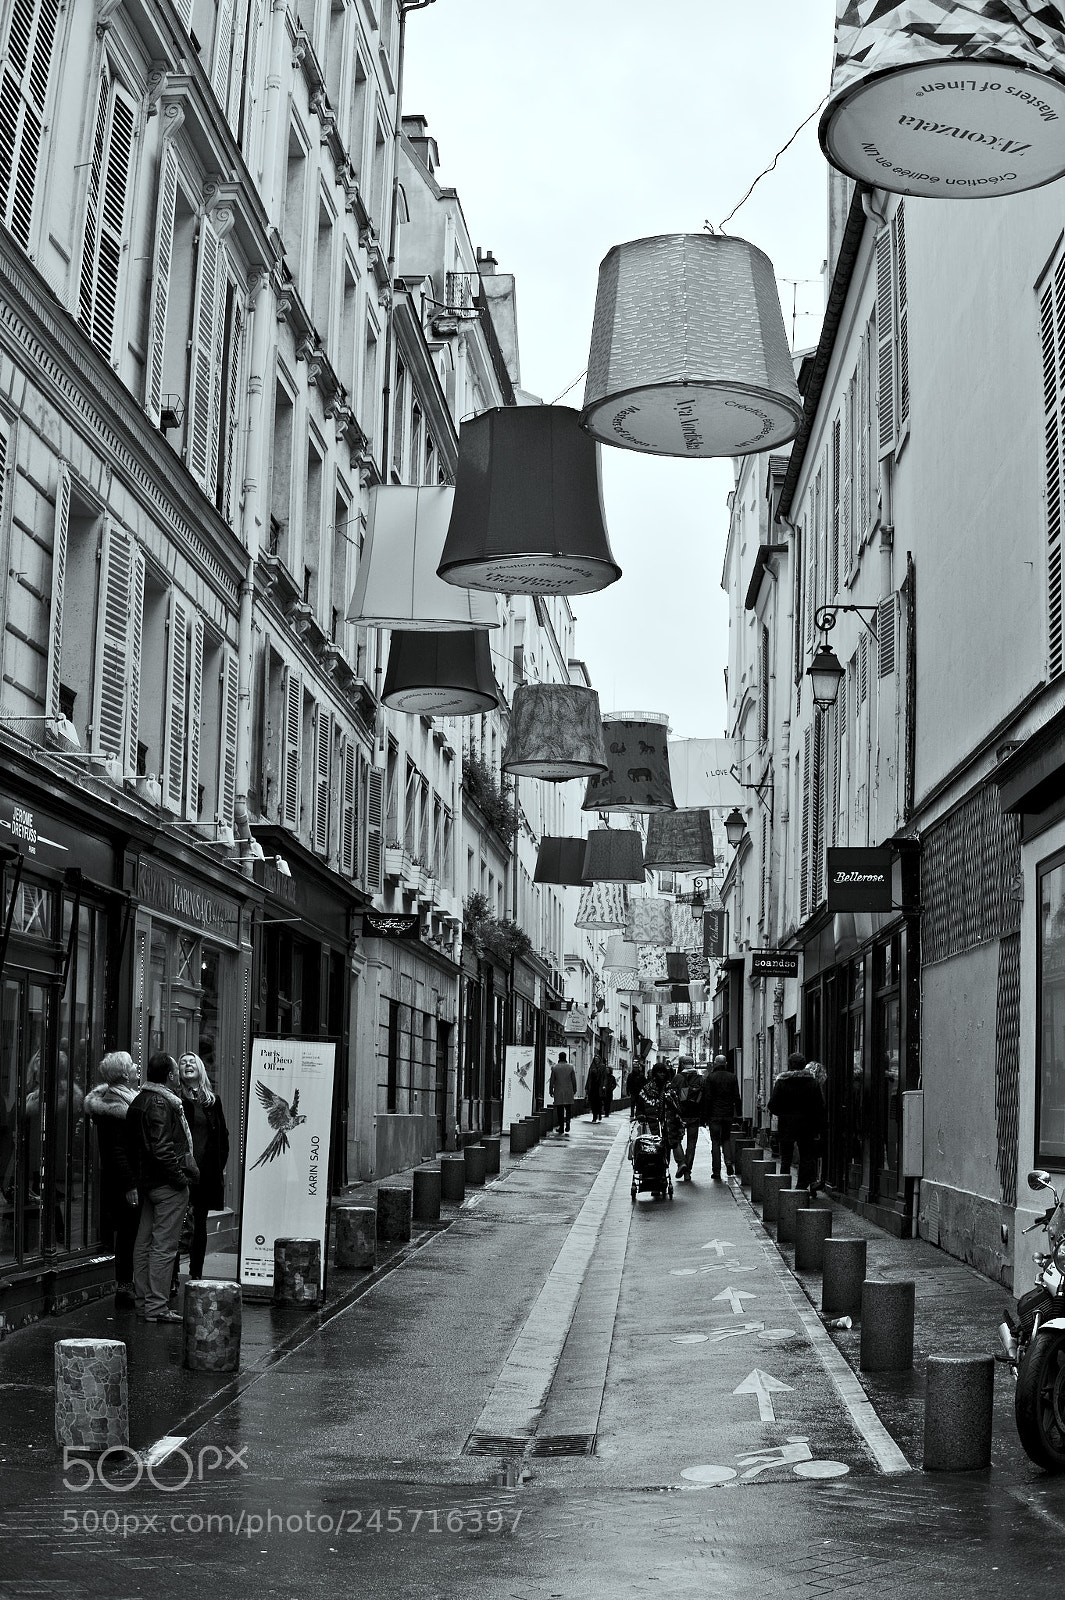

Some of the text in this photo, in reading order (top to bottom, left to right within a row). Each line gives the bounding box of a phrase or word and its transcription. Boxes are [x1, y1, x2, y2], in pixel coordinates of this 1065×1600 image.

[915, 80, 1059, 122] Masters of Linen®
[860, 142, 1017, 187] Création éditée en LIN
[612, 405, 640, 426] Masters
[724, 400, 768, 419] Création
[755, 434, 765, 442] en
[710, 769, 728, 777] LOVE
[12, 806, 34, 828] JEROME
[12, 821, 37, 844] DREYFUSS
[173, 884, 213, 928] KARIN SAJO
[754, 959, 796, 968] soandso
[260, 1049, 281, 1057] Paris
[273, 1056, 293, 1065] Déco
[308, 1135, 320, 1196] KARIN SAJO
